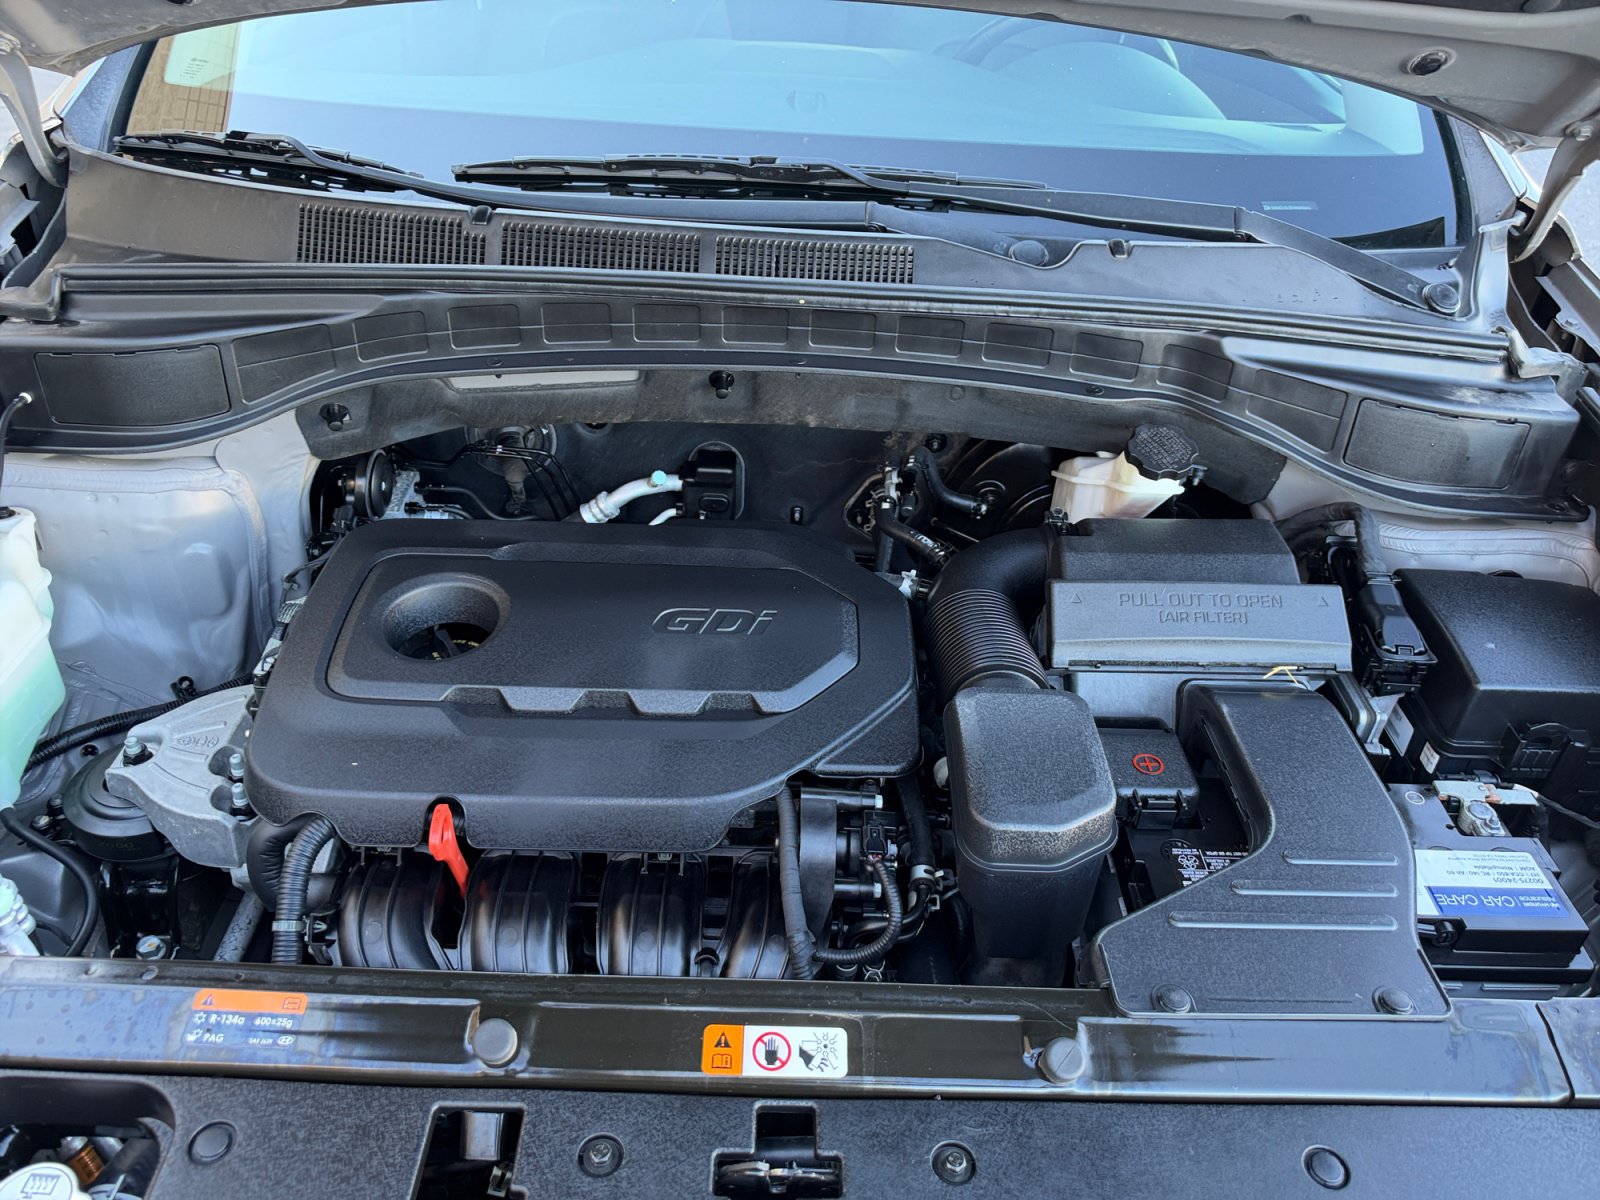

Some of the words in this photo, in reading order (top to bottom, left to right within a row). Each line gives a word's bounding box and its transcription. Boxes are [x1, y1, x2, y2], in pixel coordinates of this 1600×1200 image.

[1118, 592, 1164, 607] PULL
[1168, 593, 1202, 607] OUT
[1206, 593, 1233, 608] TO
[1236, 593, 1283, 608] OPEN
[1434, 894, 1478, 906] CARE
[1480, 895, 1515, 907] CAR
[209, 1014, 245, 1025] R-134a
[203, 1033, 224, 1042] PAG
